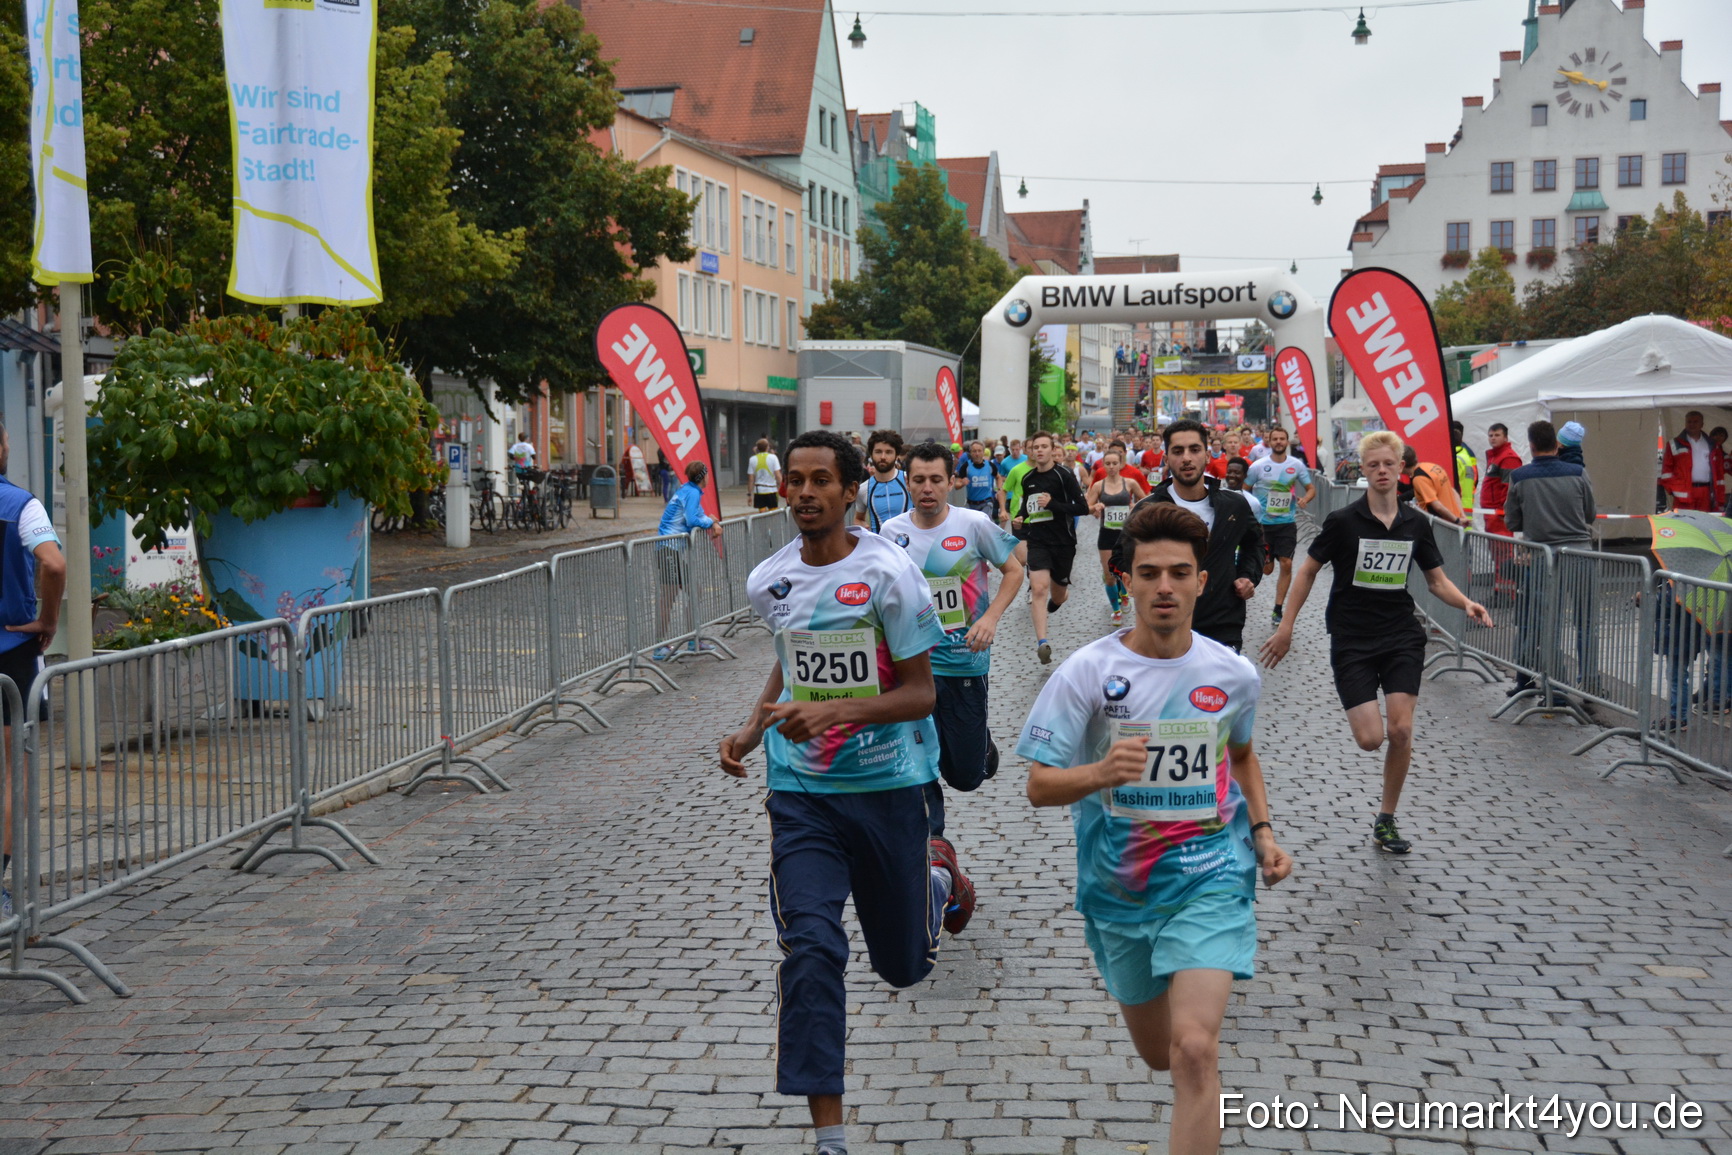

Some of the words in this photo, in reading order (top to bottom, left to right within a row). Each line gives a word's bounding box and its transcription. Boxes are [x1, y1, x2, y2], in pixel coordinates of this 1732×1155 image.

[232, 83, 279, 108] Wir
[287, 86, 341, 113] sind
[238, 120, 360, 151] Fairtrade-
[243, 157, 316, 182] Stadt!
[1041, 285, 1116, 308] BMW
[1123, 281, 1257, 309] Laufsport
[1198, 377, 1224, 387] ZIEL
[451, 448, 459, 460] P
[1269, 497, 1290, 507] 5219
[1363, 552, 1407, 571] 5277
[1370, 575, 1394, 583] Adrian
[840, 587, 869, 600] Hervis
[819, 632, 867, 645] BOCK
[795, 650, 869, 684] 5250
[1195, 691, 1225, 706] Hervis
[1159, 721, 1209, 735] BOCK
[859, 749, 898, 766] Stadtlauf
[1169, 789, 1217, 806] Ibrahim
